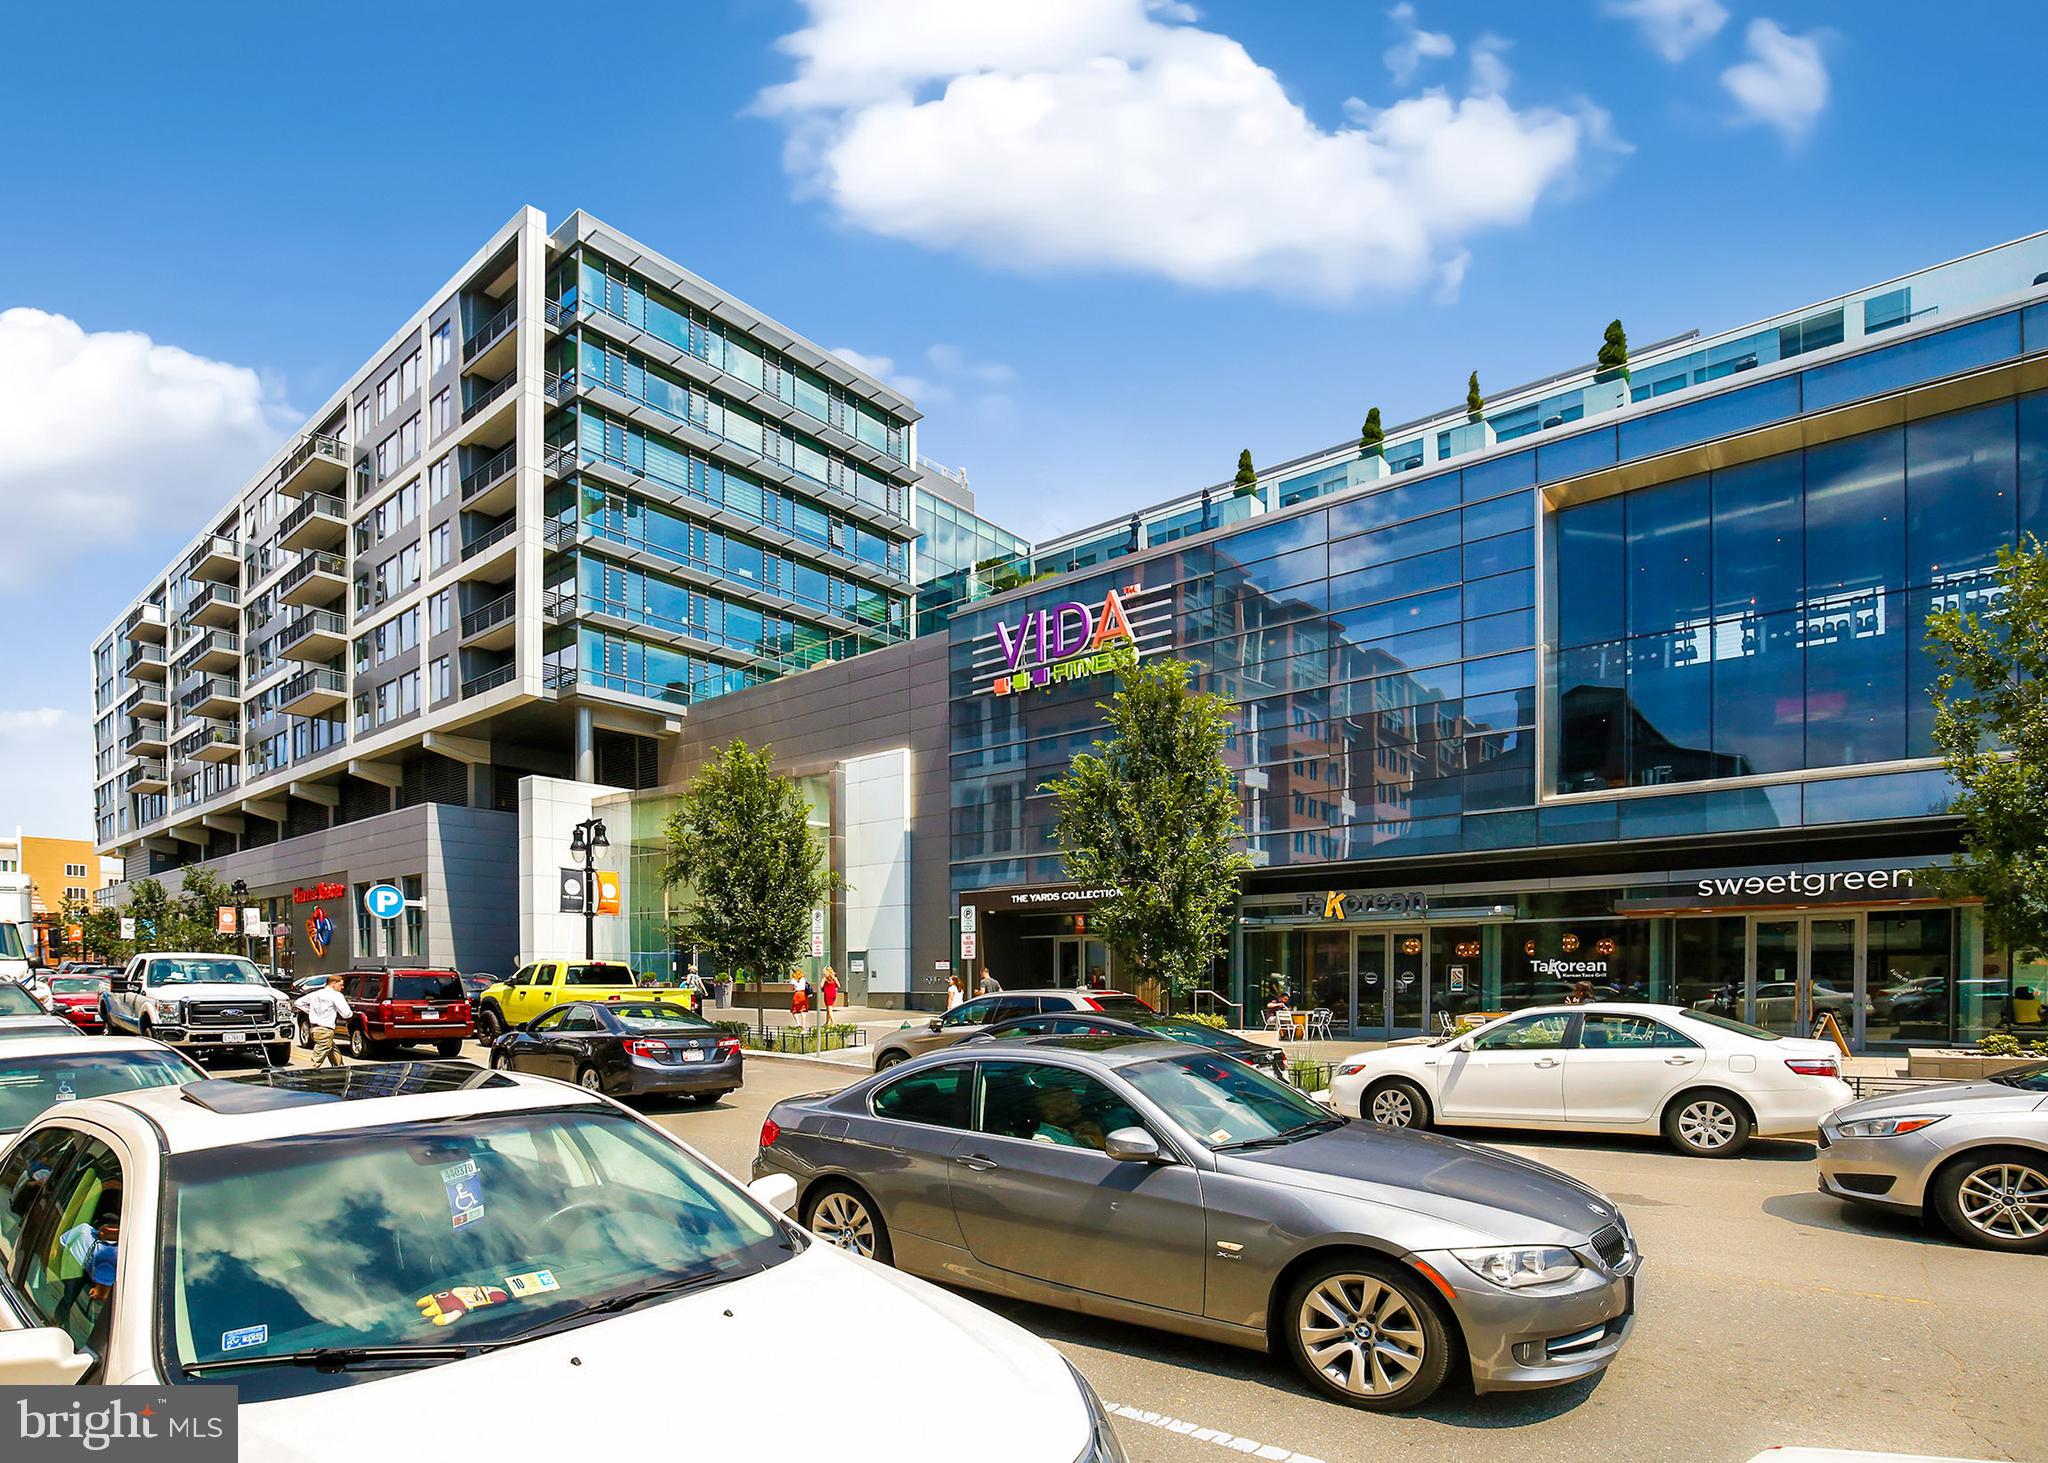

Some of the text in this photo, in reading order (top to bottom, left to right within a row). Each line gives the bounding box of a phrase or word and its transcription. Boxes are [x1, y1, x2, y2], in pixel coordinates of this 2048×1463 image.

[994, 589, 1136, 671] VIDA
[1697, 868, 1914, 897] sweetgreen
[376, 890, 399, 912] P
[1011, 888, 1124, 903] THE YARDS COLLECTION
[1296, 890, 1427, 919] TaKorean
[1530, 959, 1607, 978] TaKorean
[512, 1277, 526, 1290] 10
